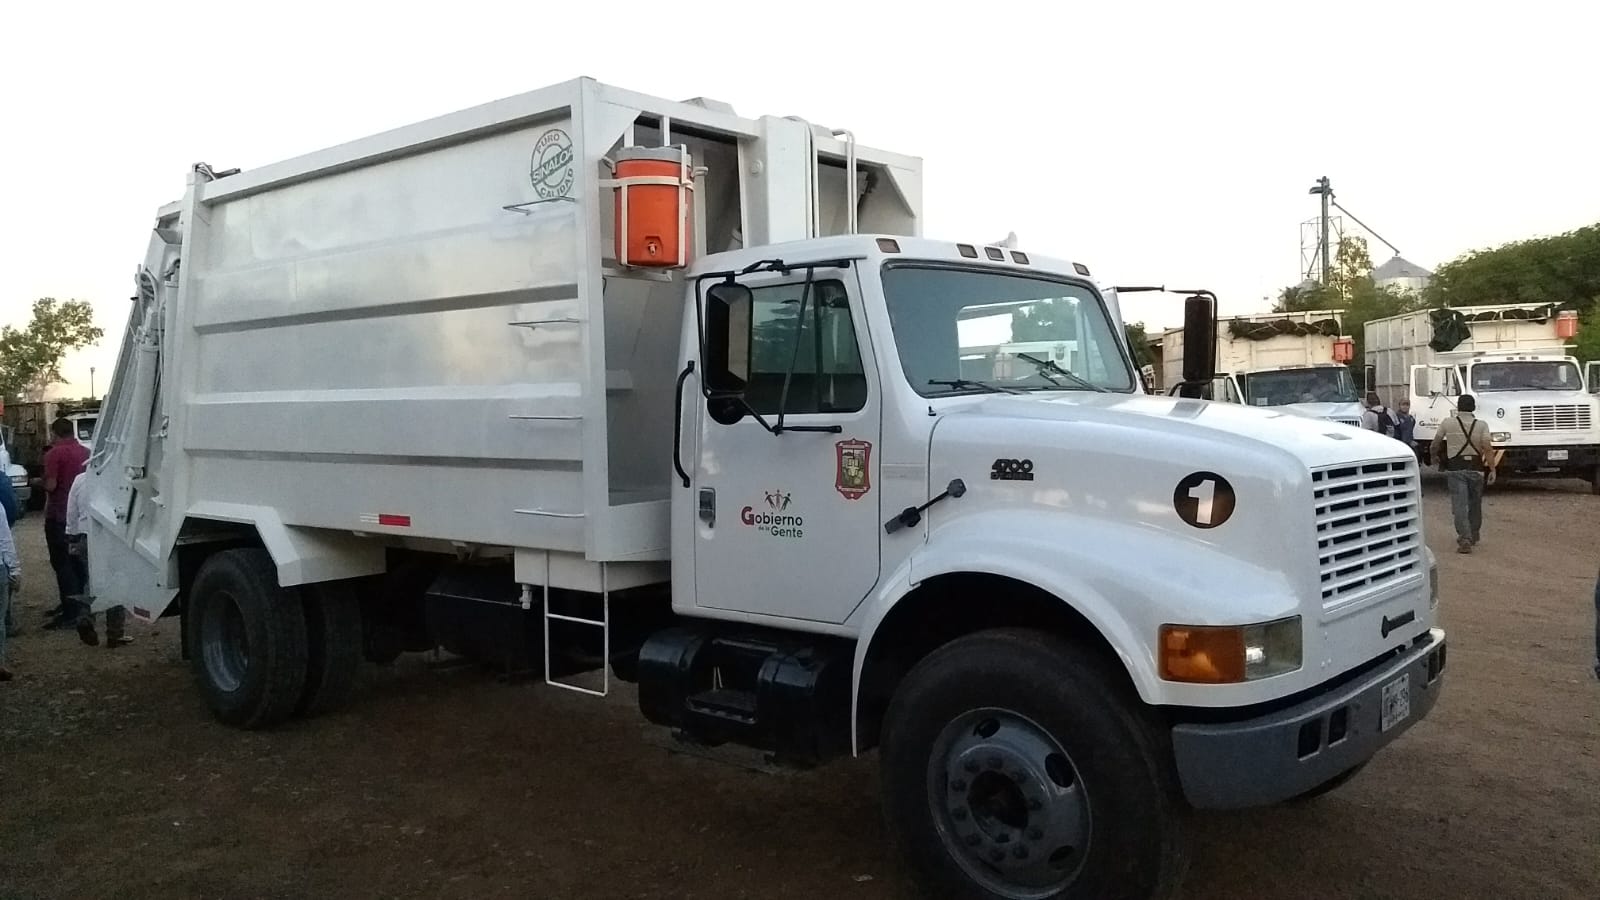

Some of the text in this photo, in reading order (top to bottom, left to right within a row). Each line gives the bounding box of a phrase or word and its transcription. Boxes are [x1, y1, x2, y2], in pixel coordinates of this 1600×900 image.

[536, 133, 560, 154] PURO
[540, 168, 574, 197] CALIDAD
[1188, 479, 1215, 524] 1
[741, 506, 803, 526] Gobierno
[770, 526, 803, 538] Gente
